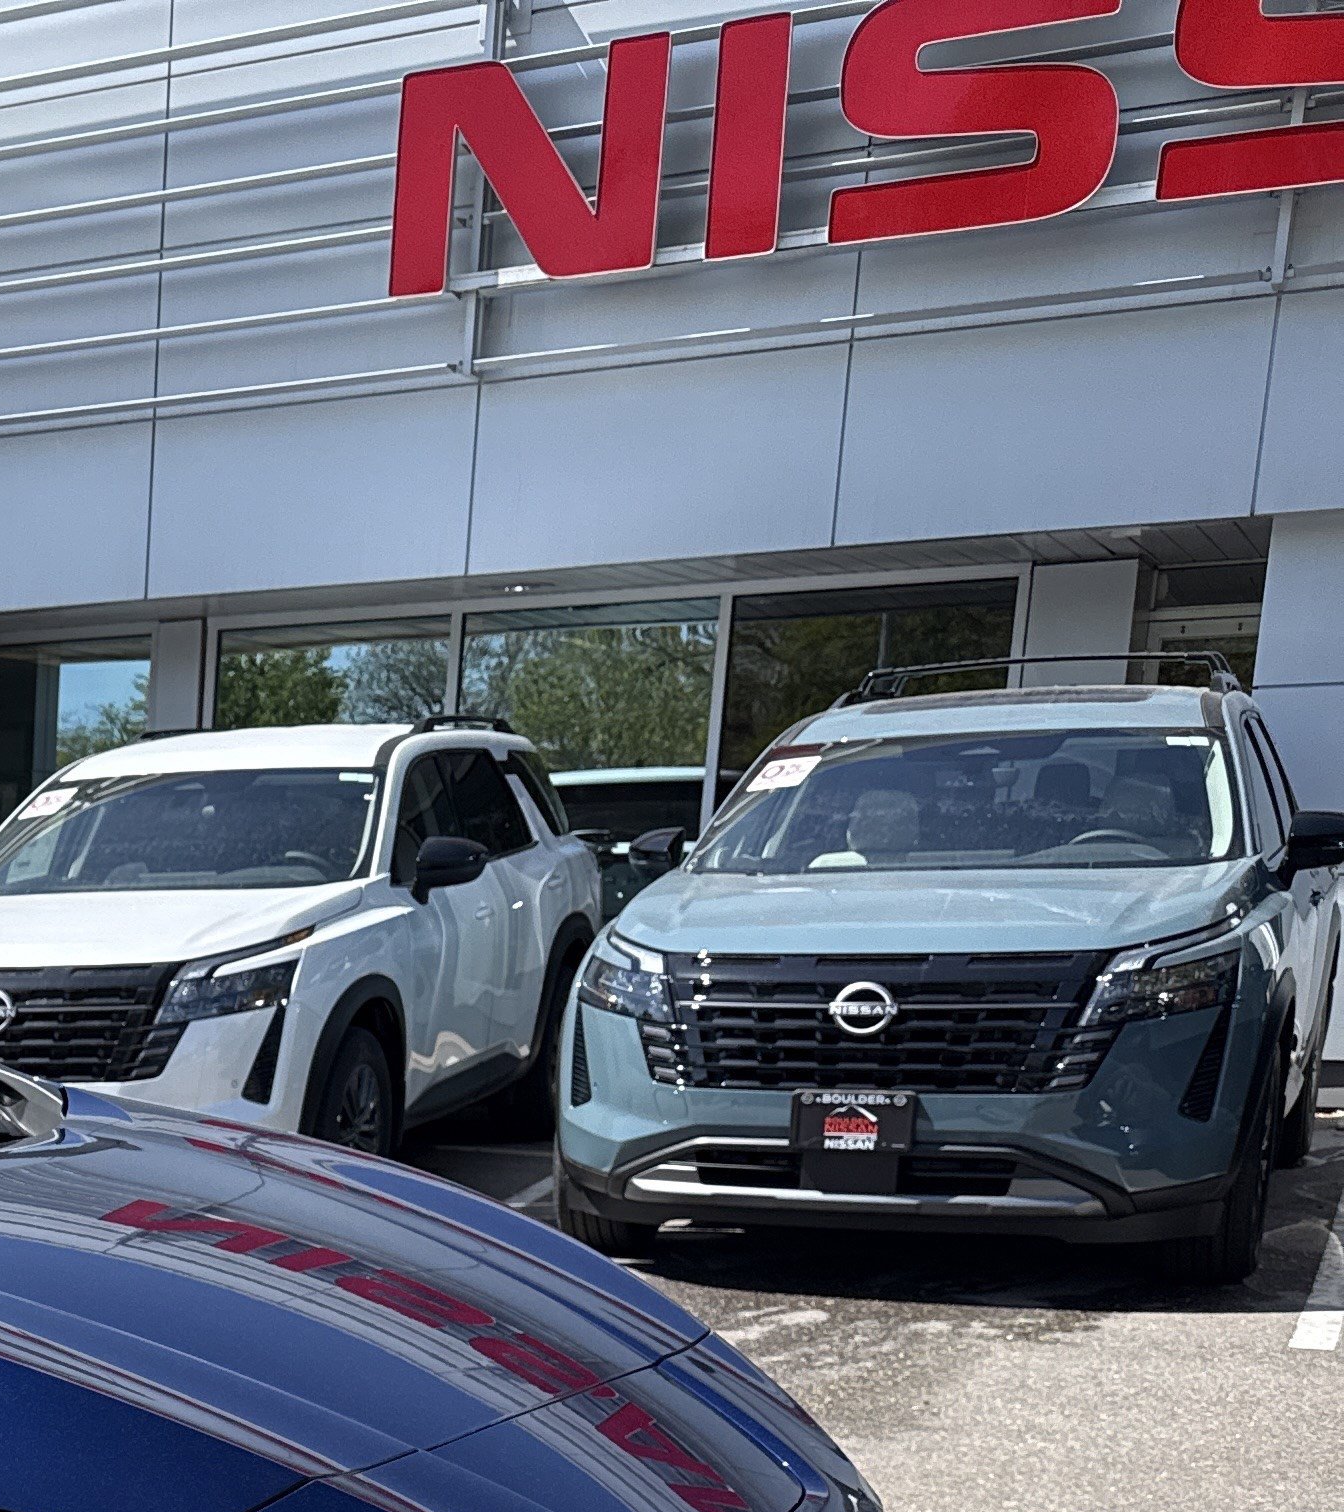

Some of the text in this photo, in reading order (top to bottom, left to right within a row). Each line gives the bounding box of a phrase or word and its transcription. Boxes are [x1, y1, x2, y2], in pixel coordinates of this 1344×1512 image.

[829, 1002, 898, 1016] NISSAN
[822, 1093, 886, 1105] BOULDER
[823, 1138, 875, 1151] NISSAN
